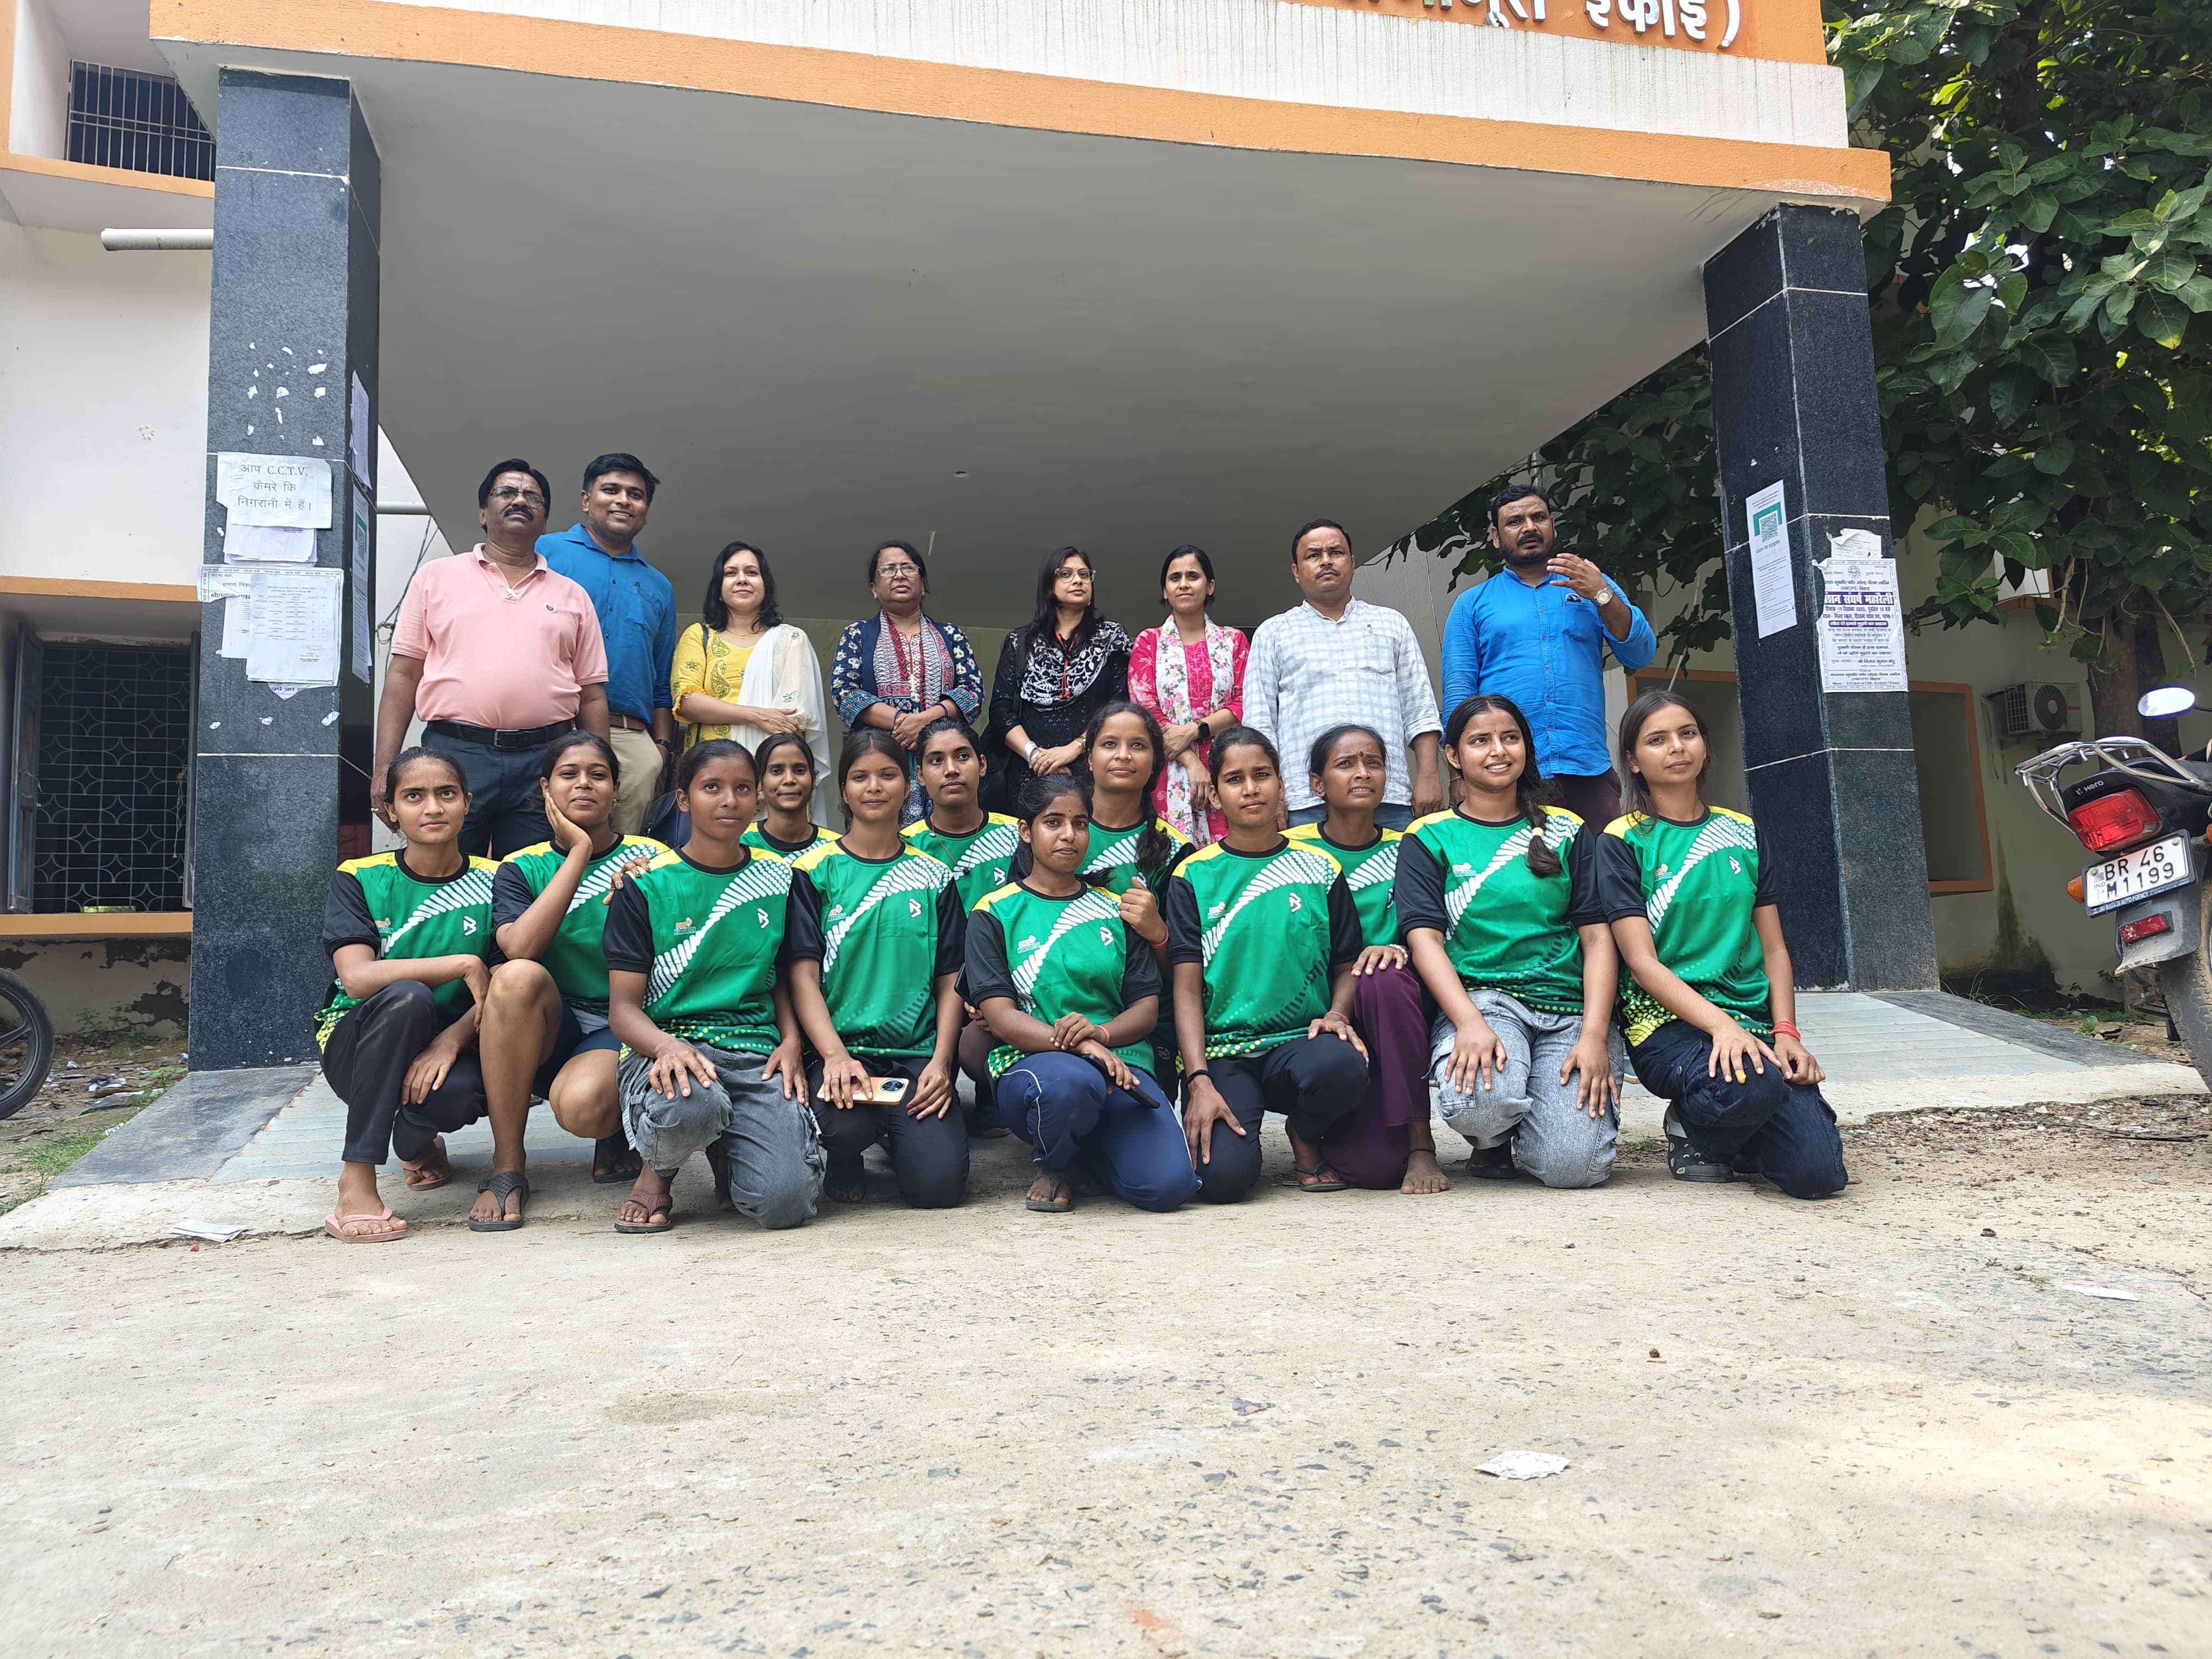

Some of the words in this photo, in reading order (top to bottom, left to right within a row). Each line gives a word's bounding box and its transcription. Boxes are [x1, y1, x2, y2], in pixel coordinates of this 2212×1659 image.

[240, 464, 261, 473] आप
[267, 466, 308, 476] C.C.T.V.
[253, 479, 277, 491] कैमरे
[284, 481, 297, 492] कि
[238, 495, 278, 508] निगरानी
[1842, 592, 1863, 604] संघर्ष
[2083, 780, 2104, 792] Hero
[2105, 858, 2129, 881] BR
[2140, 846, 2164, 867] 46
